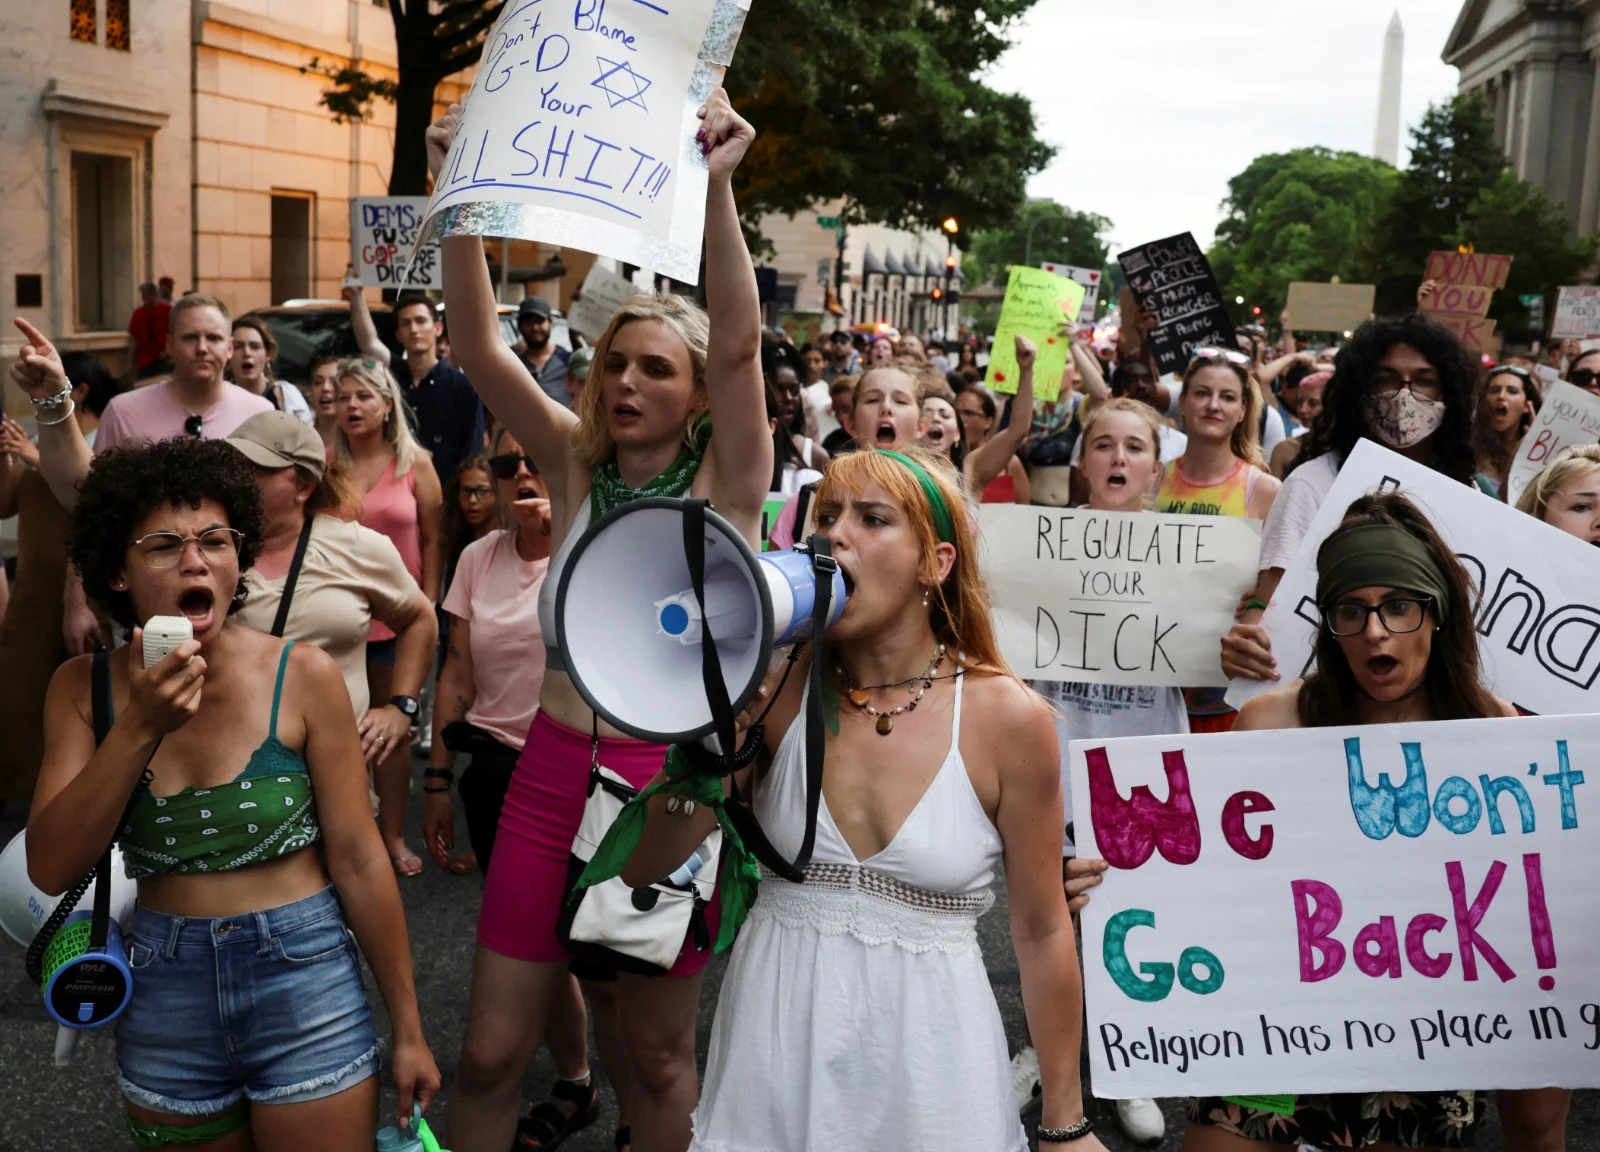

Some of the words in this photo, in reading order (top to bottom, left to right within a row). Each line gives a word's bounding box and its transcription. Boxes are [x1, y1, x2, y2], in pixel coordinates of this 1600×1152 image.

[487, 11, 542, 65] Don't
[574, 0, 637, 51] Blame
[485, 34, 570, 93] G-D
[540, 82, 593, 117] Your
[362, 204, 415, 229] DEMS
[362, 243, 398, 264] GOP
[1147, 237, 1201, 267] POWER
[376, 264, 432, 285] DICKS
[1150, 258, 1205, 286] PEOPLE
[1424, 254, 1512, 290] DONT
[1154, 292, 1216, 321] TRONGER
[1162, 285, 1197, 304] MUCH
[1432, 286, 1486, 309] YOU
[1160, 352, 1176, 363] IN
[1543, 397, 1578, 426] you
[1167, 499, 1187, 513] MY
[1036, 514, 1216, 565] REGULATE
[1079, 569, 1145, 596] YOUR
[1035, 606, 1178, 673] DICK
[1091, 683, 1136, 703] SAUCE
[1084, 746, 1276, 870] We
[1343, 737, 1585, 840] Won't
[79, 964, 107, 973] PYLE
[1102, 908, 1225, 1002] Go
[1099, 1021, 1244, 1073] Religion
[1259, 1014, 1331, 1054] has
[1345, 1020, 1396, 1050] no
[1411, 1009, 1513, 1060] place
[1529, 1005, 1565, 1040] in
